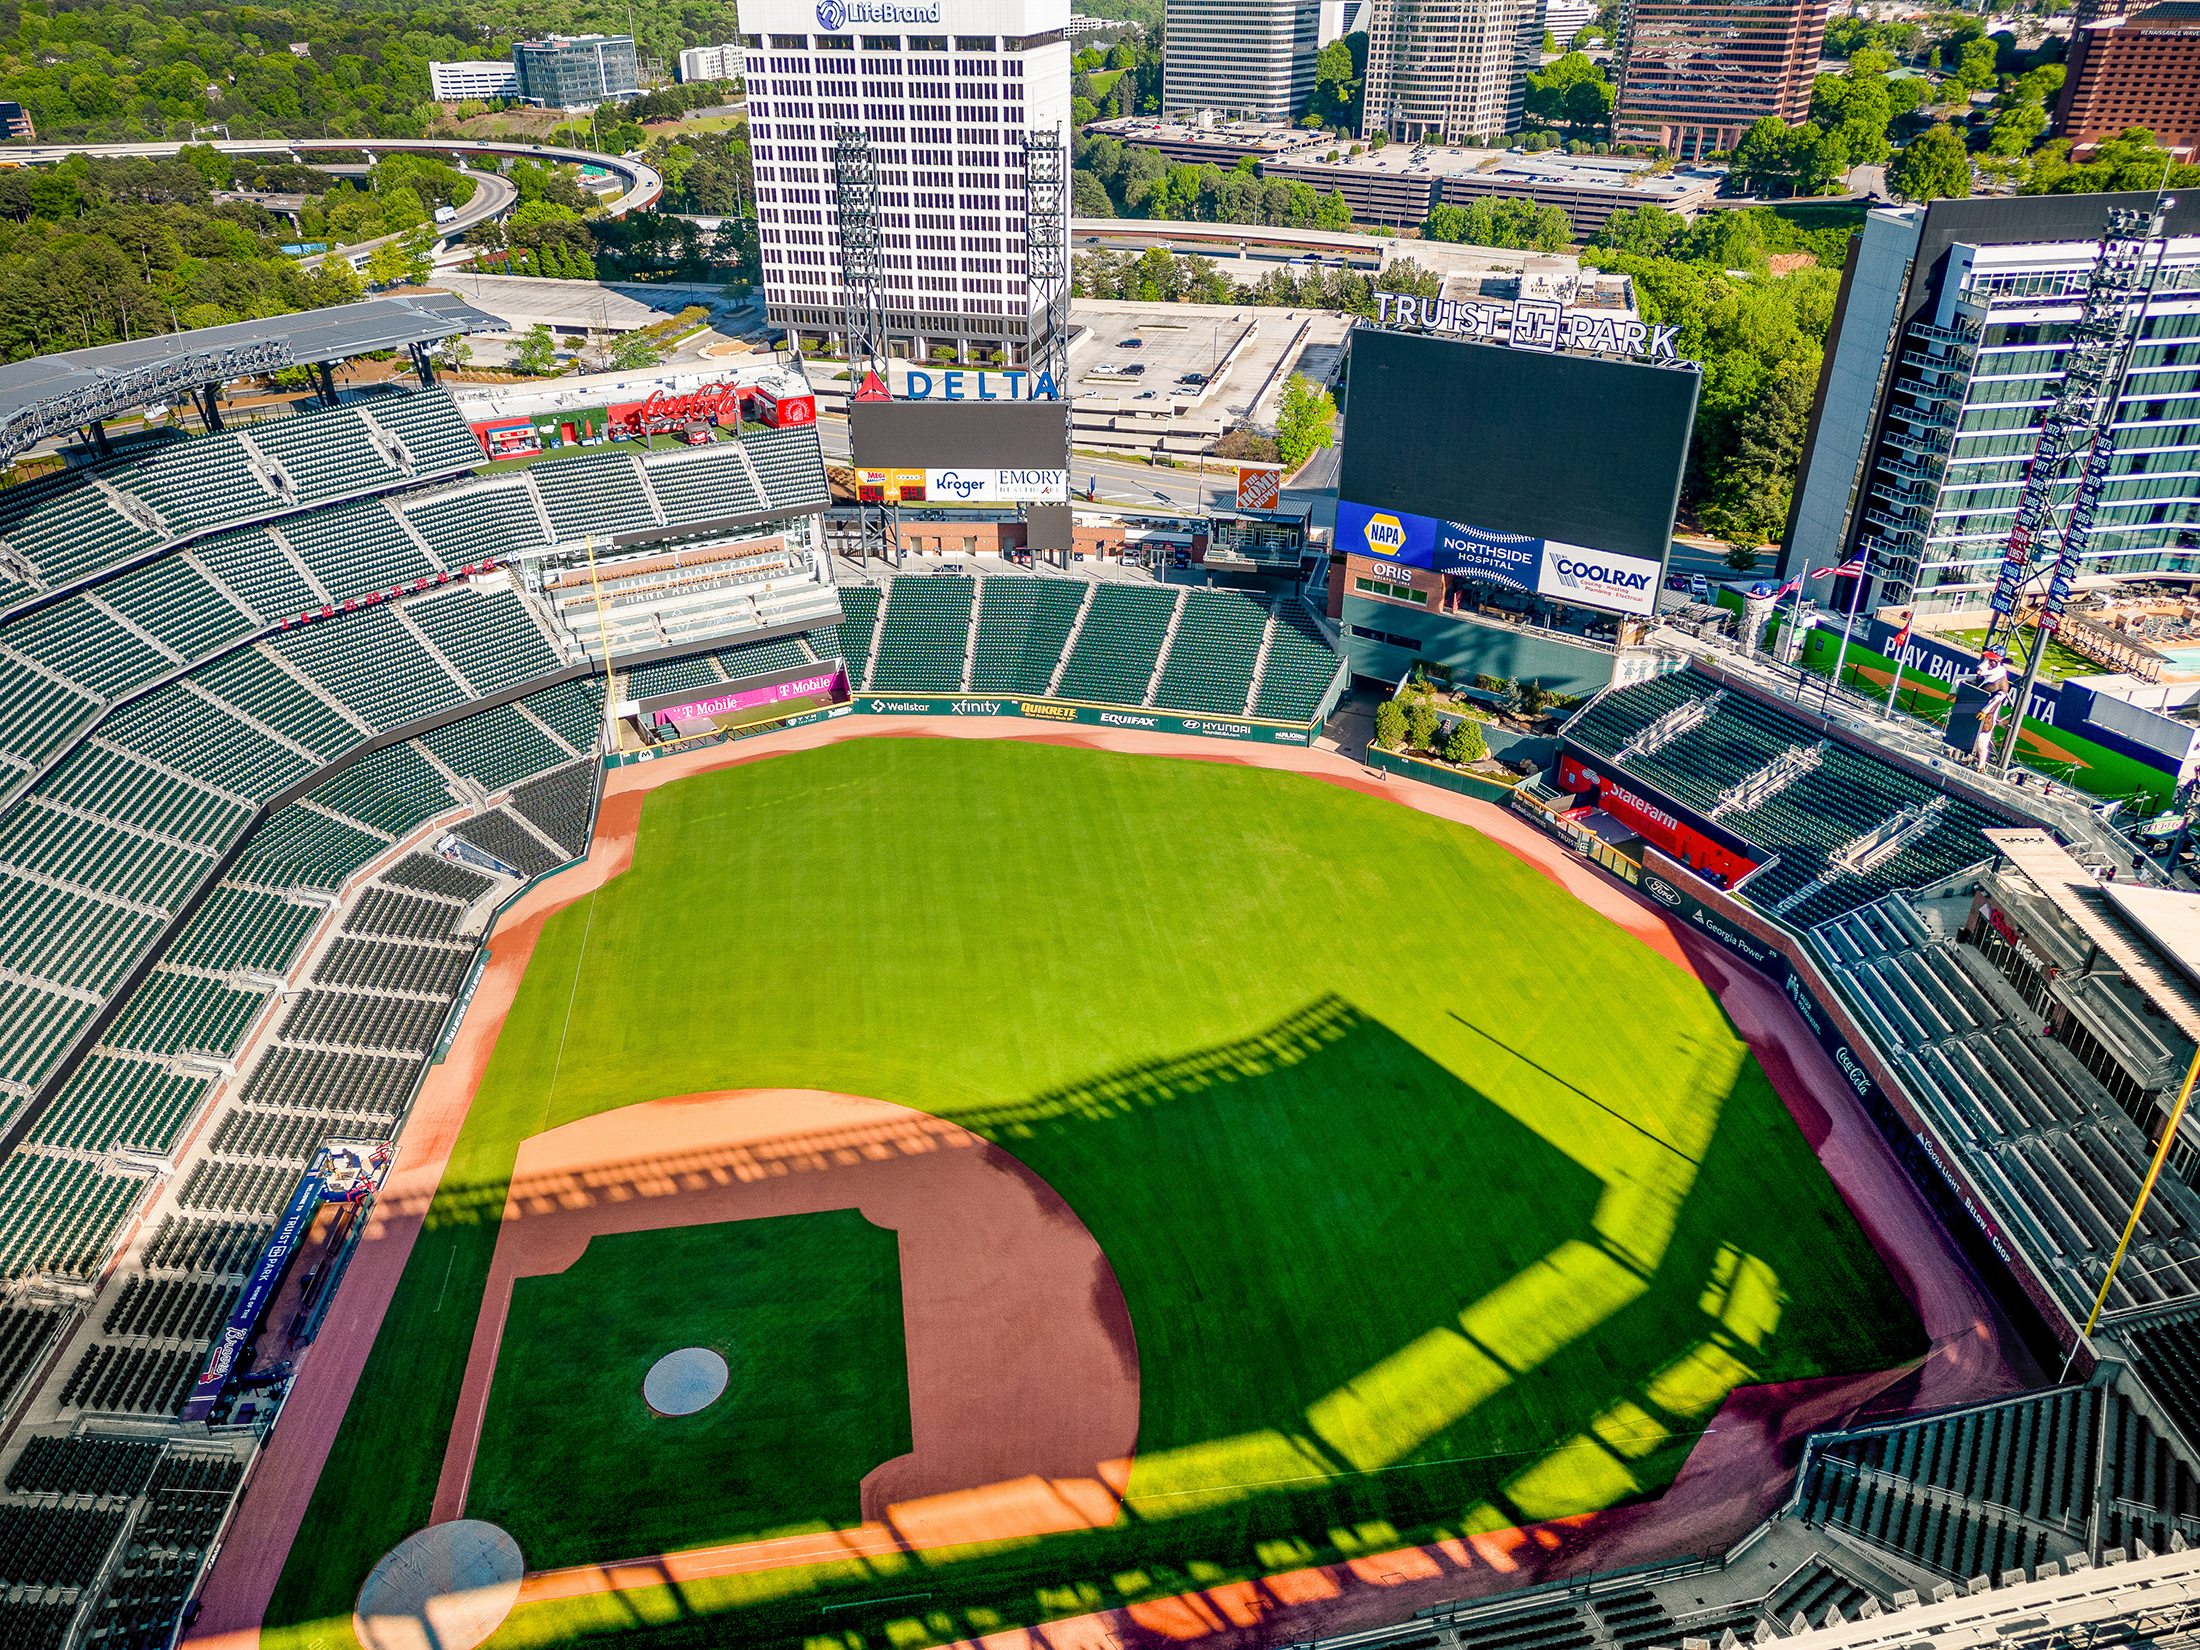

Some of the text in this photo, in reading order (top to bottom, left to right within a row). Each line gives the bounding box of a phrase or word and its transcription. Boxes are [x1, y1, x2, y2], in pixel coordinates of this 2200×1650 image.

[848, 2, 940, 23] LifeBrand
[1373, 291, 1683, 358] TRUIST PARK
[907, 371, 1059, 399] DELTA
[643, 380, 740, 424] Coca-Cola
[2044, 422, 2060, 436] 1872
[2040, 441, 2055, 454] 1874
[2096, 436, 2112, 450] 1873
[2034, 459, 2049, 472] 1877
[2091, 455, 2106, 468] 1875
[999, 470, 1063, 484] EMORY
[1242, 473, 1260, 489] THE
[2029, 477, 2044, 490] 1883
[2085, 474, 2100, 488] 1878
[937, 472, 985, 498] Kroger
[1238, 470, 1280, 507] HOME
[1252, 484, 1280, 508] DEPOT
[2024, 495, 2039, 508] 1892
[2080, 492, 2094, 506] 1891
[2019, 513, 2034, 526] 1897
[2074, 510, 2090, 524] 1893
[1371, 523, 1399, 545] NAPA
[2014, 530, 2028, 543] 1914
[1444, 537, 1533, 565] NORTHSIDE
[2009, 547, 2023, 560] 1957
[2063, 547, 2079, 560] 1948
[1458, 553, 1514, 571] HOSPITAL
[461, 564, 475, 576] 44
[1372, 563, 1412, 582] ORIS
[1557, 559, 1652, 590] COOLRAY
[2058, 564, 2073, 578] 1958
[414, 577, 429, 590] 35
[438, 572, 449, 583] 41
[391, 585, 403, 597] 31
[1580, 580, 1629, 594] Cooling Heating
[1584, 586, 1643, 602] Plumbing Electrical
[1999, 581, 2012, 594] 1991
[2052, 581, 2067, 595] 1982
[344, 599, 358, 611] 21
[366, 592, 382, 605] 29
[1994, 598, 2008, 612] 1993
[2047, 599, 2063, 612] 1992
[301, 612, 310, 623] 6
[321, 605, 334, 618] 10
[280, 618, 290, 629] 3
[2042, 616, 2057, 629] 1995
[1883, 636, 1928, 671] PLAY
[792, 678, 831, 694] Mobile
[697, 698, 737, 715] Mobile
[887, 703, 929, 711] Wellstar
[951, 700, 1001, 715] xfinity
[1021, 702, 1077, 717] QUIKRETE
[1100, 713, 1155, 726] EQUIFAX
[1202, 722, 1250, 734] HYUNDAI
[1557, 831, 1578, 848] TRUIST
[1650, 880, 1675, 902] Ford
[1706, 919, 1764, 961] Georgia Power
[1991, 908, 2044, 972] Coors LIGHT
[1836, 1047, 1871, 1095] Coca-Cola
[1924, 1138, 1942, 1168] Coors
[1942, 1166, 1960, 1193] LIGHT
[1964, 1196, 1987, 1230] BELOW
[1992, 1236, 2011, 1262] CHOP
[278, 1215, 300, 1244] TRUIST
[258, 1258, 277, 1281] PARK
[217, 1327, 248, 1374] Braves
